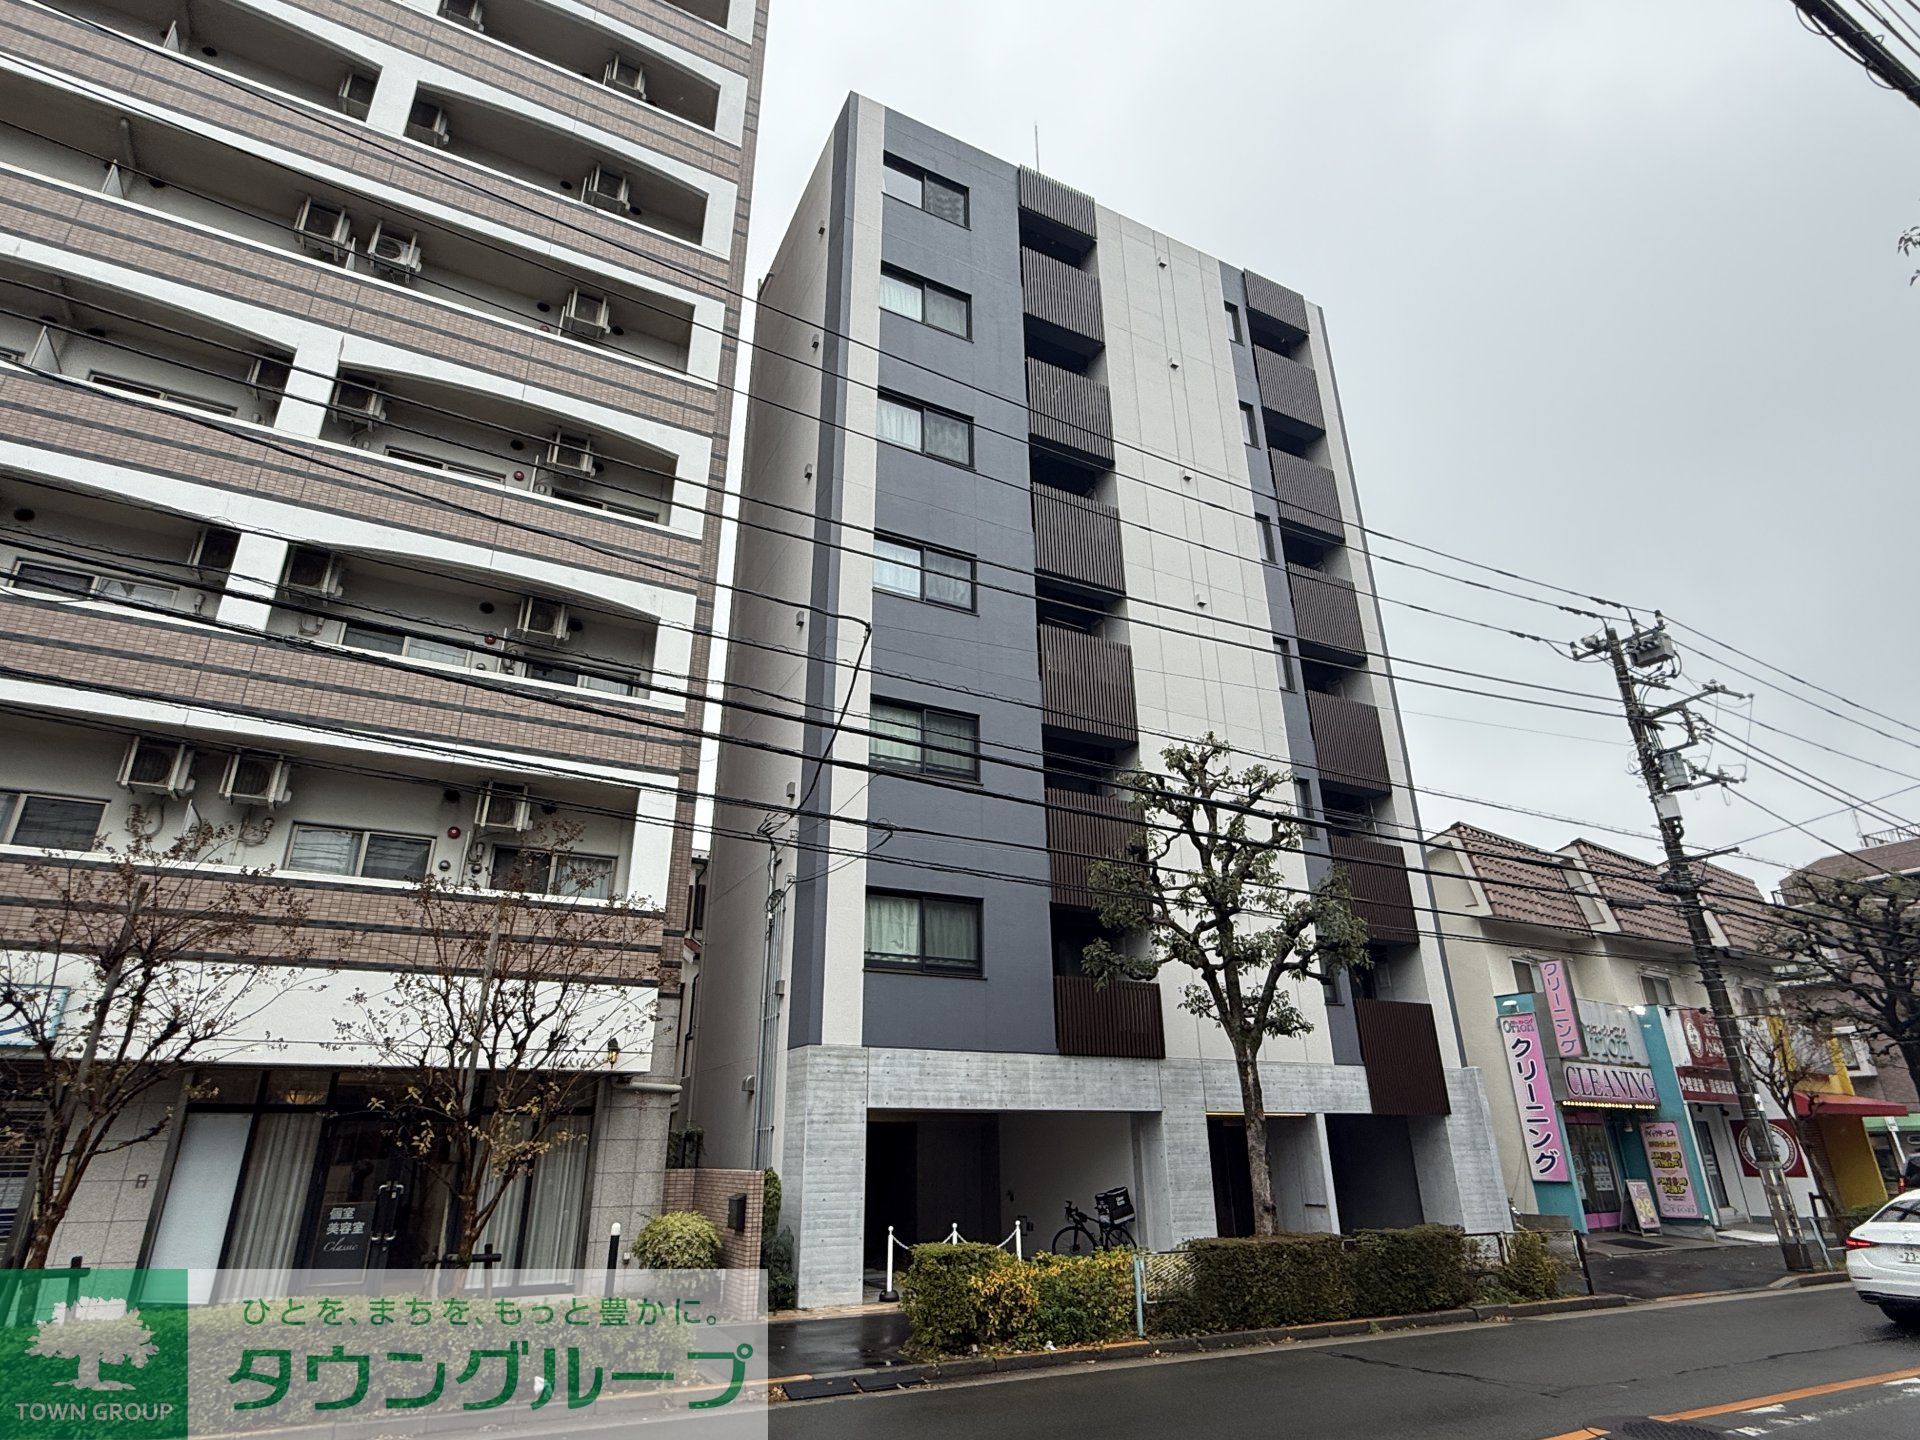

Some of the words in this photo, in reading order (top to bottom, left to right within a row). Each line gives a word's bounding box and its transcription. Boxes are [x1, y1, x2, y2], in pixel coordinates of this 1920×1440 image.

[1544, 962, 1577, 1054] クリーニング
[1565, 1065, 1656, 1100] CLEANING
[1511, 1037, 1559, 1175] クリーニング
[326, 1221, 366, 1236] 美容室
[329, 1207, 356, 1220] 個室
